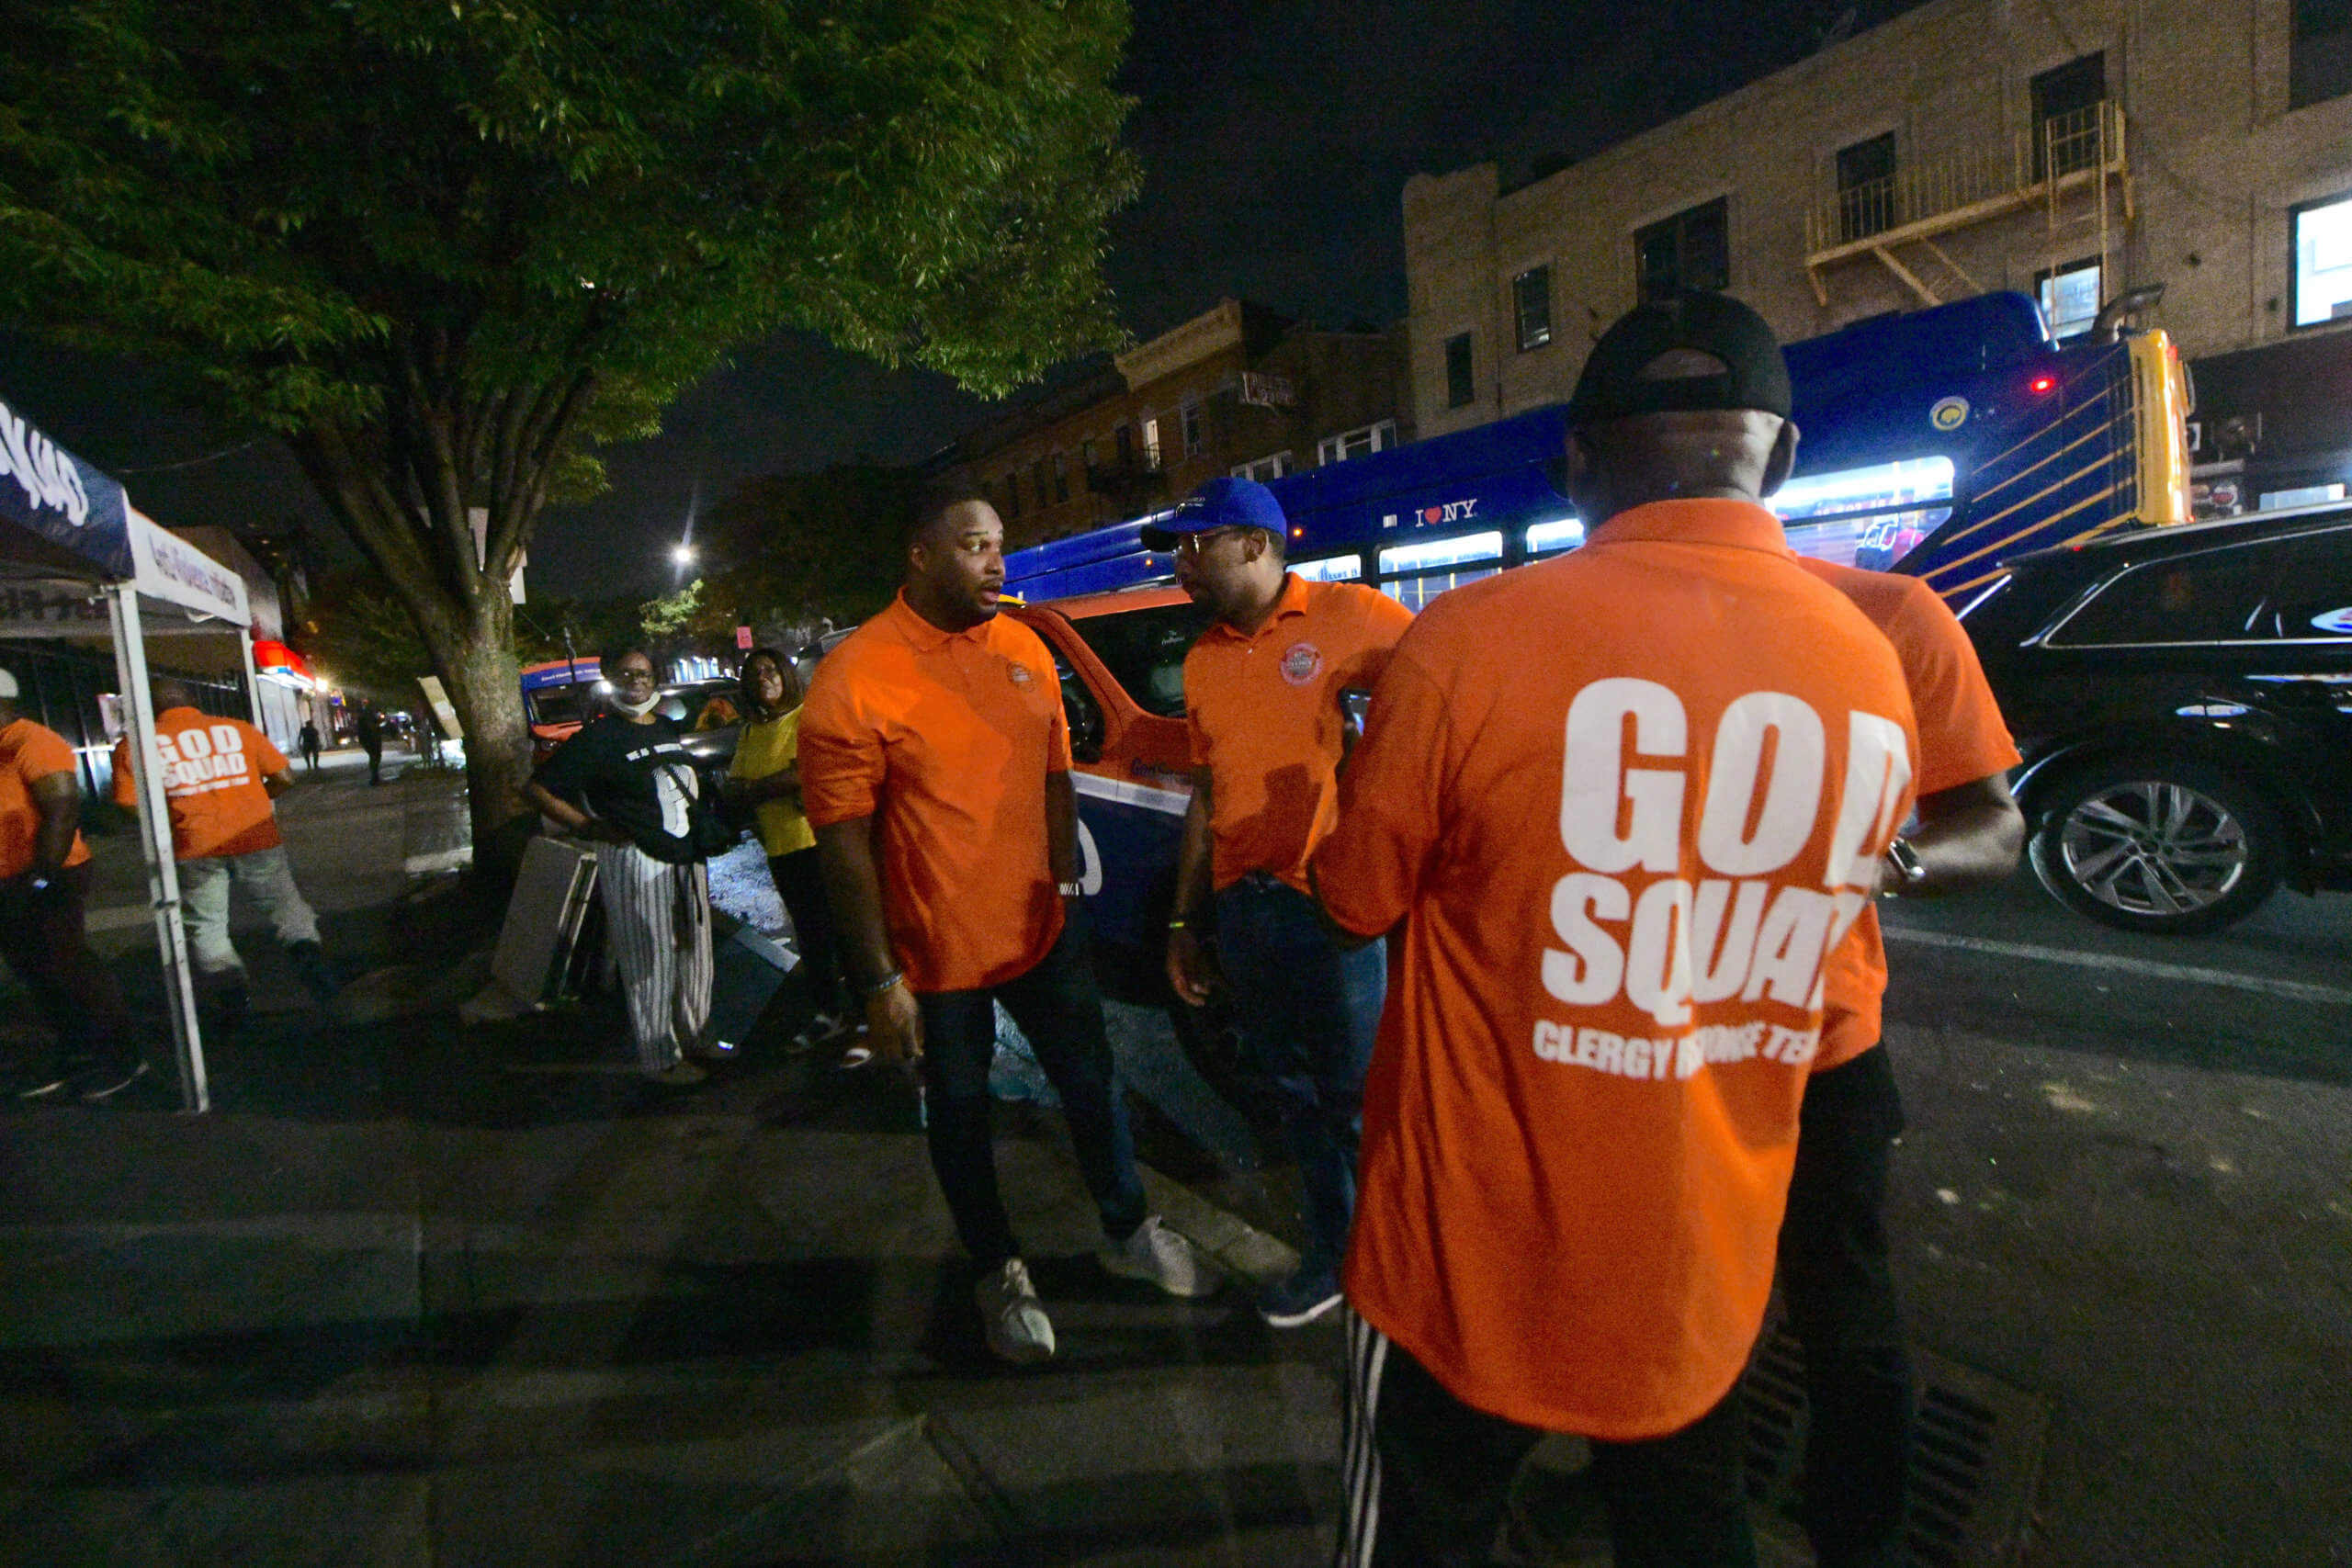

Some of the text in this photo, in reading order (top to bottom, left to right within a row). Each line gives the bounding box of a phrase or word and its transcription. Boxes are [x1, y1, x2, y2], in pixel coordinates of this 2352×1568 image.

[155, 725, 243, 764] GOD
[162, 752, 248, 789] SQUAD
[1559, 677, 1912, 888] GOD
[1532, 1019, 1675, 1081] CLERGY
